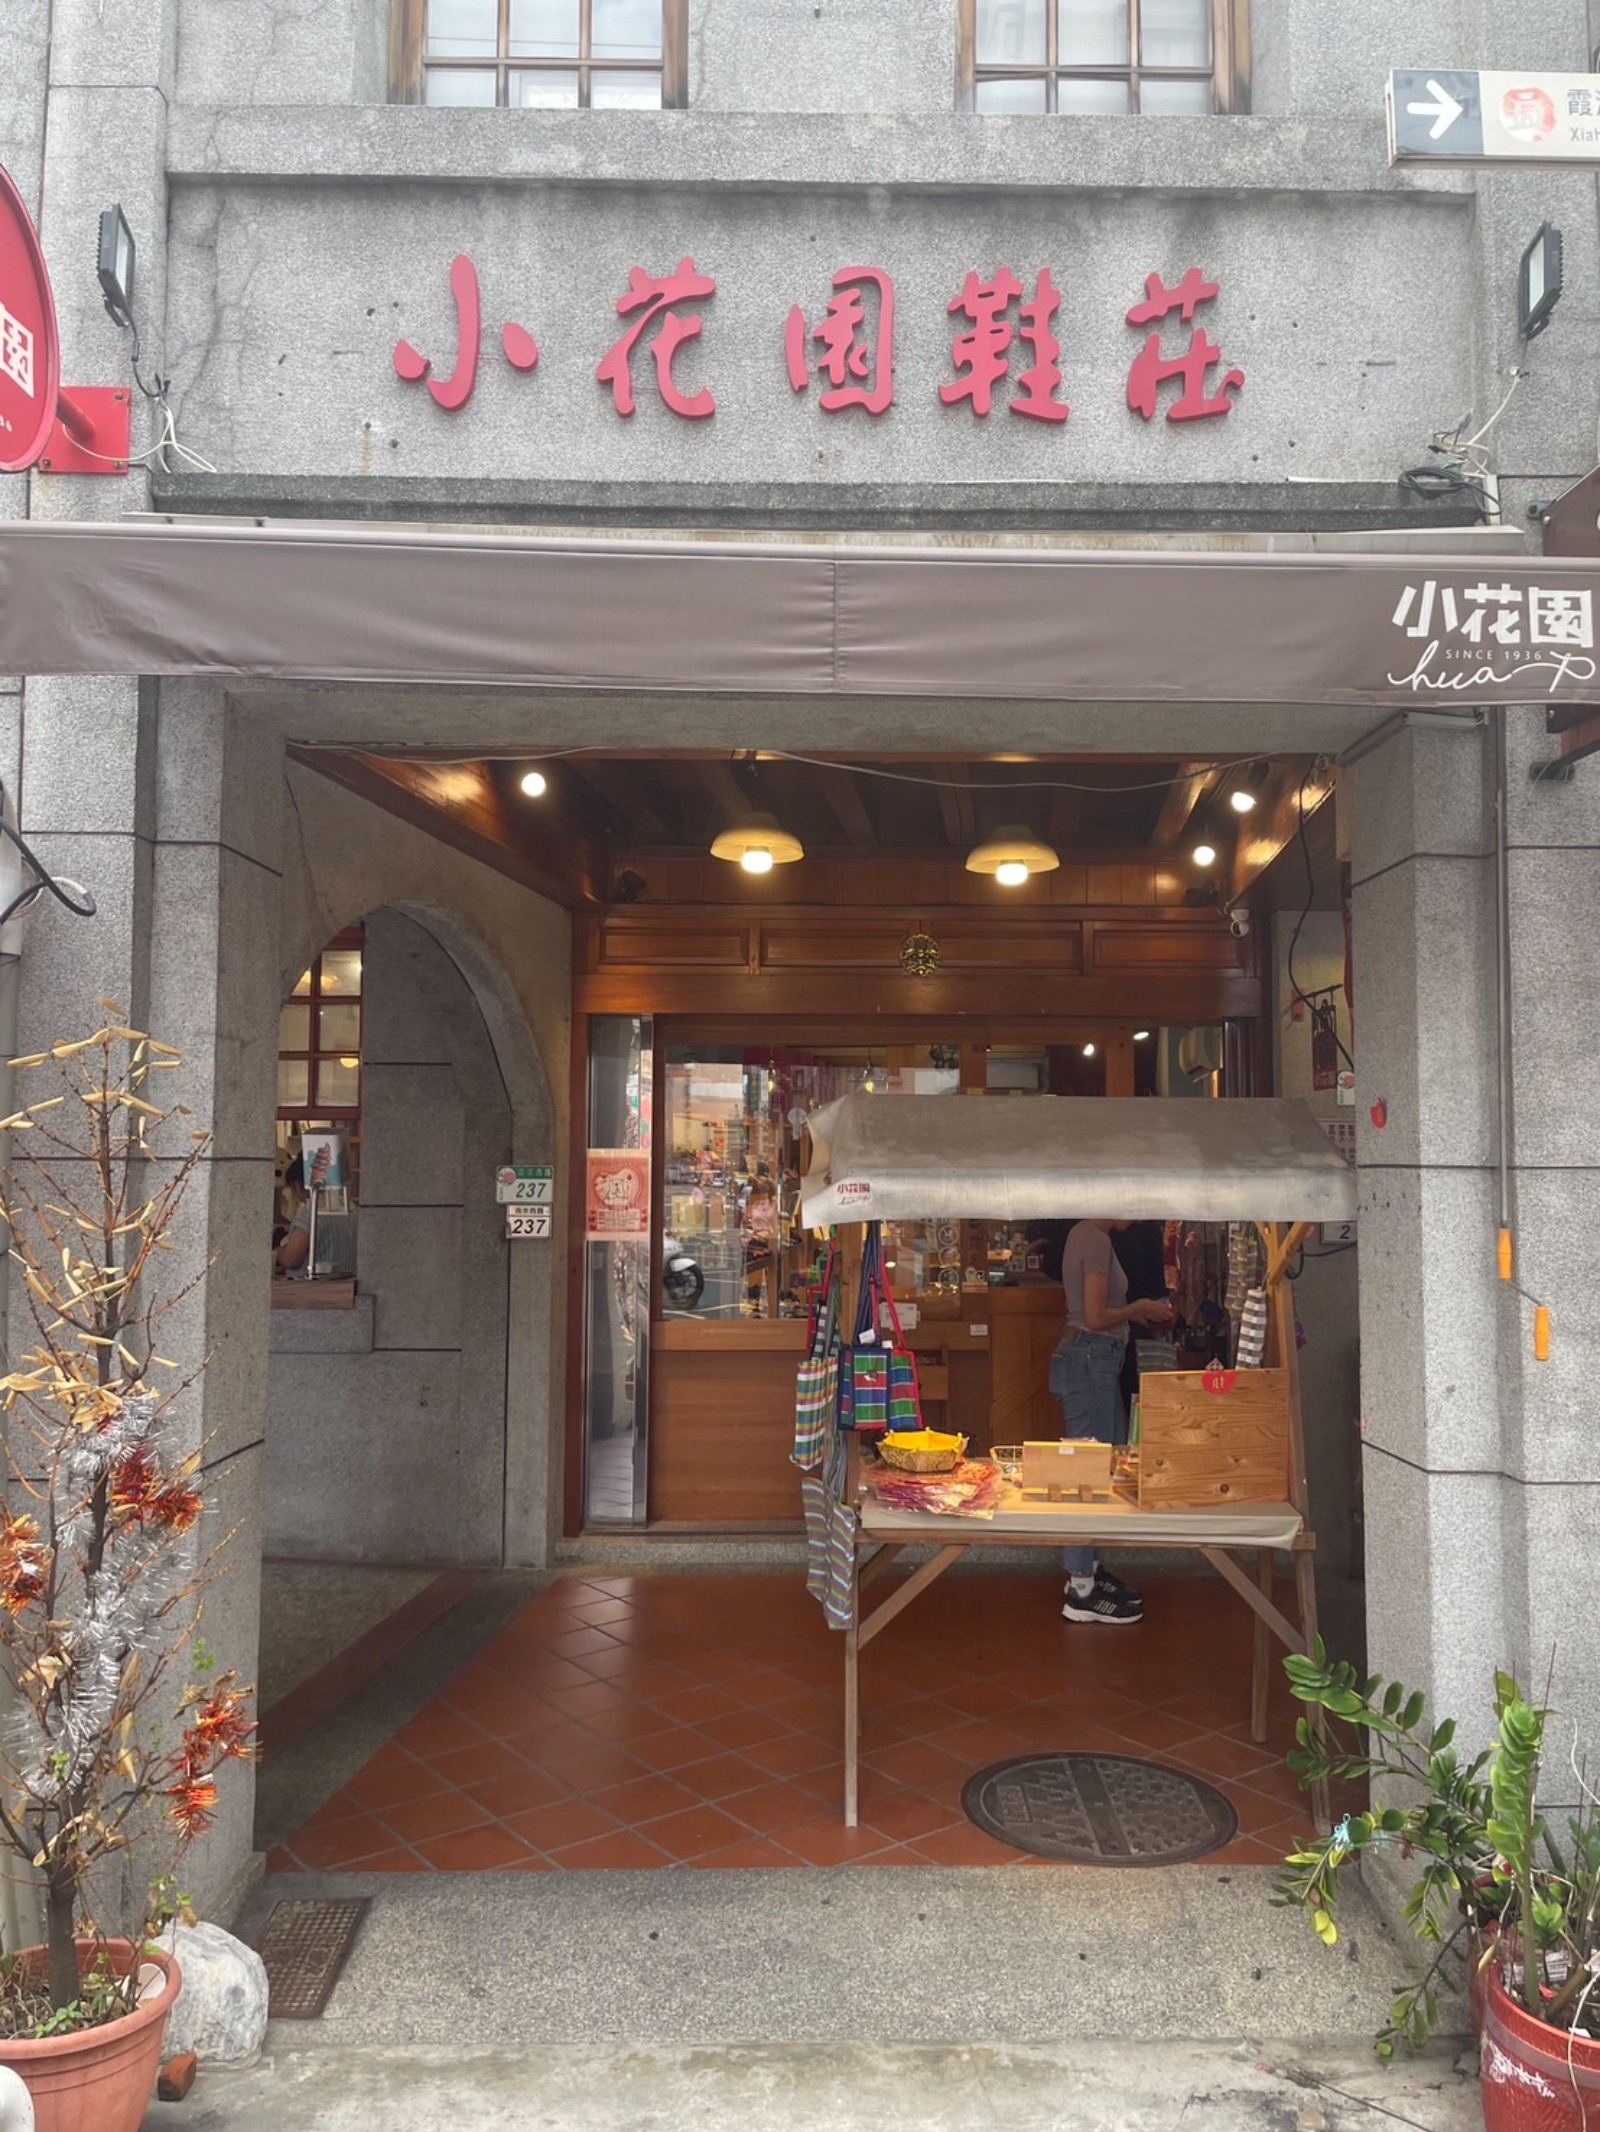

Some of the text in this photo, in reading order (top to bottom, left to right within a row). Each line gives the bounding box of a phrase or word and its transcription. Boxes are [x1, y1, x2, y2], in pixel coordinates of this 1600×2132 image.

[393, 253, 1245, 424] 小花園鞋莊
[1391, 579, 1595, 649] 小花園
[1445, 648, 1543, 661] SINCE 1936
[515, 1182, 547, 1198] 237
[836, 1182, 870, 1194] 小花園
[511, 1218, 547, 1234] 237
